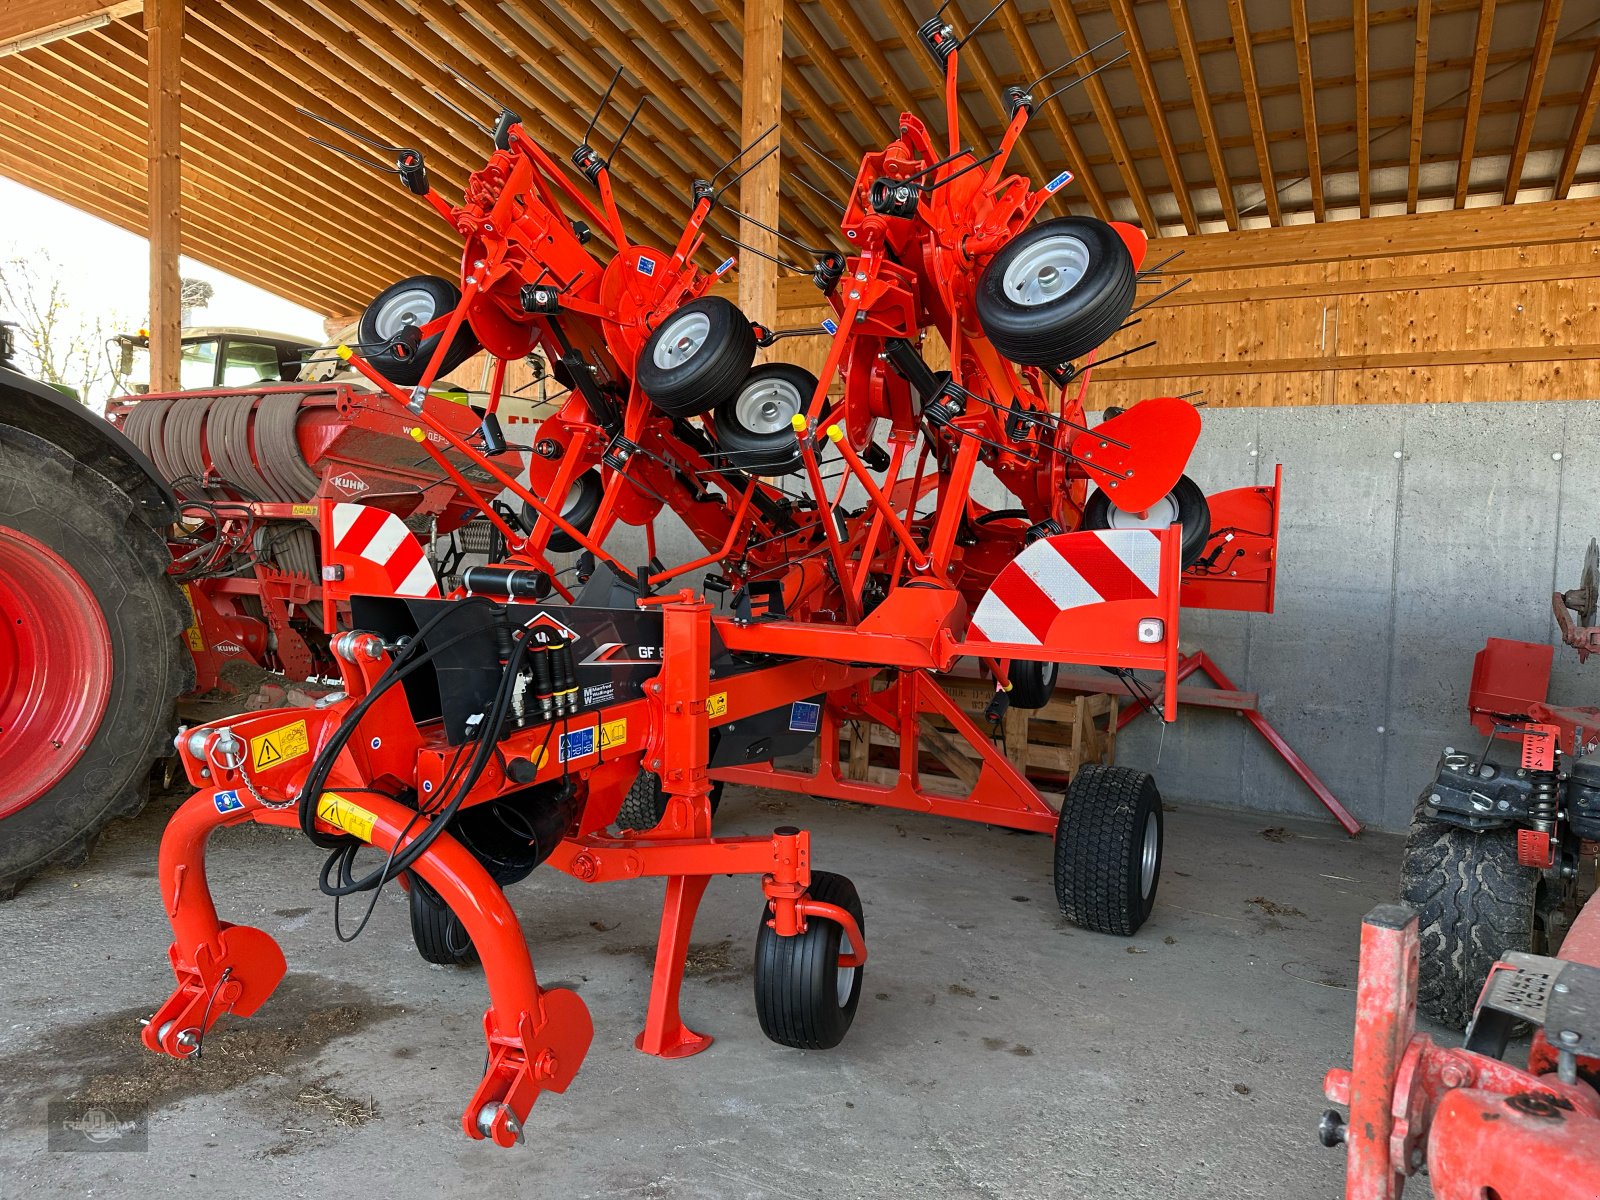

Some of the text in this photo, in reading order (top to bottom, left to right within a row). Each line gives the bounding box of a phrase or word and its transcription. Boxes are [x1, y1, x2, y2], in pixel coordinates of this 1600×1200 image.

[334, 476, 364, 491] KUHN
[638, 646, 655, 659] GF
[1535, 746, 1545, 754] 3
[1534, 759, 1544, 768] 4
